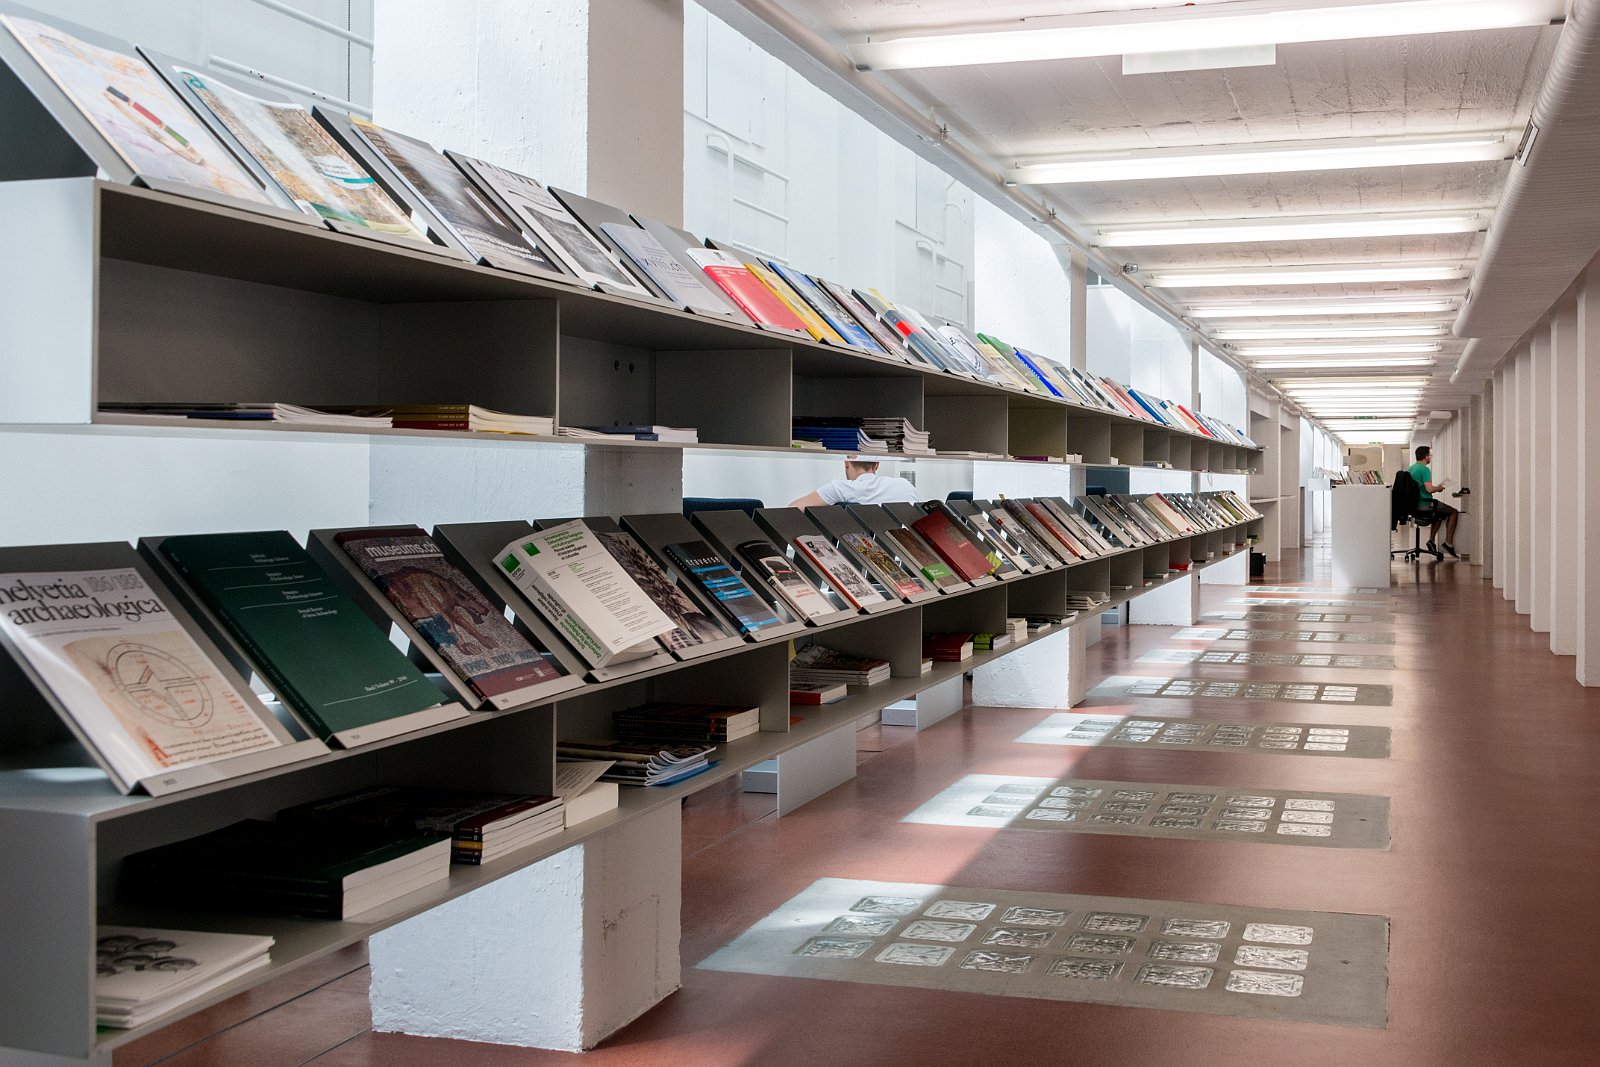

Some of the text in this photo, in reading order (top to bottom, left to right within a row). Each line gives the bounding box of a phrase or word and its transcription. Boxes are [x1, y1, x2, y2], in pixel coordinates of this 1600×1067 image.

[364, 541, 441, 557] museums.ch
[685, 556, 720, 566] traverse
[8, 595, 166, 625] archaeologica
